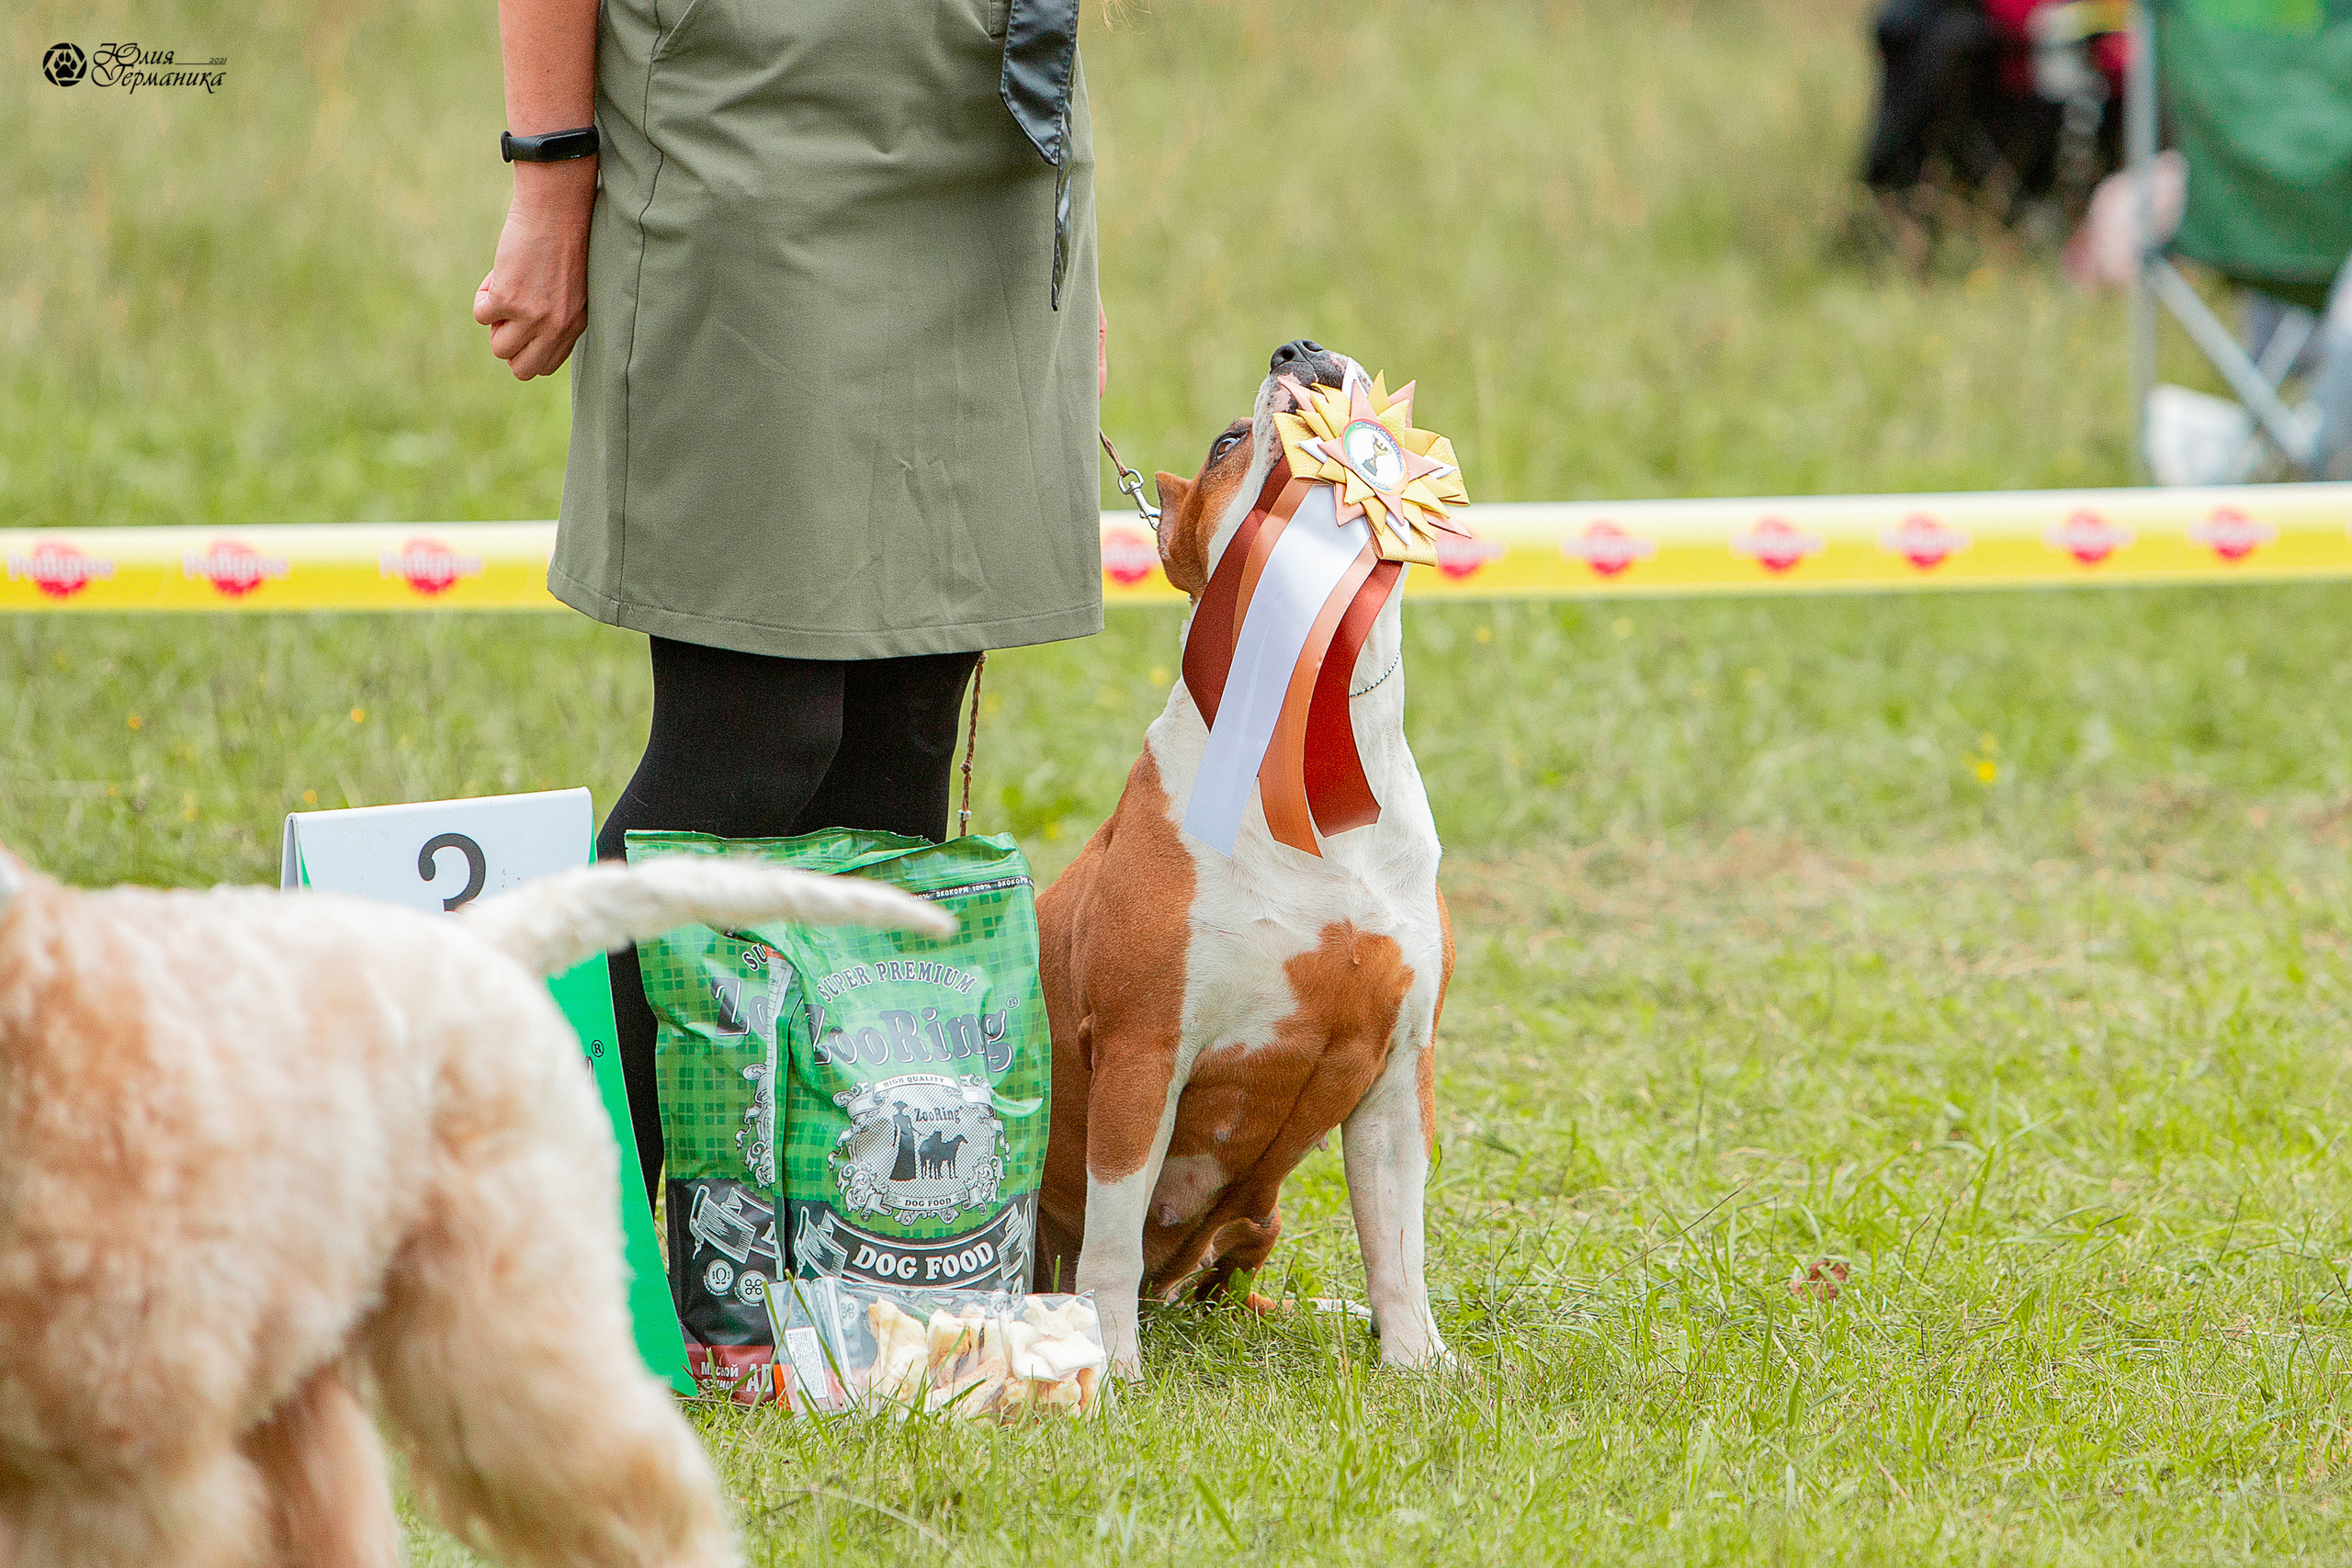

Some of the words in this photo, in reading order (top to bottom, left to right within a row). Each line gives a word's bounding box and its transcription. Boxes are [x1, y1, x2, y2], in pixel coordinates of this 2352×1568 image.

[971, 883, 991, 892] 100%
[817, 964, 872, 1003] SUPER
[875, 960, 978, 994] PREMIUM
[883, 1077, 904, 1088] HIGH
[907, 1075, 944, 1083] QUALITY
[914, 1107, 961, 1123] ZooRing
[928, 1197, 952, 1207] FOOD
[852, 1244, 918, 1280] DOG
[925, 1241, 994, 1280] FOOD
